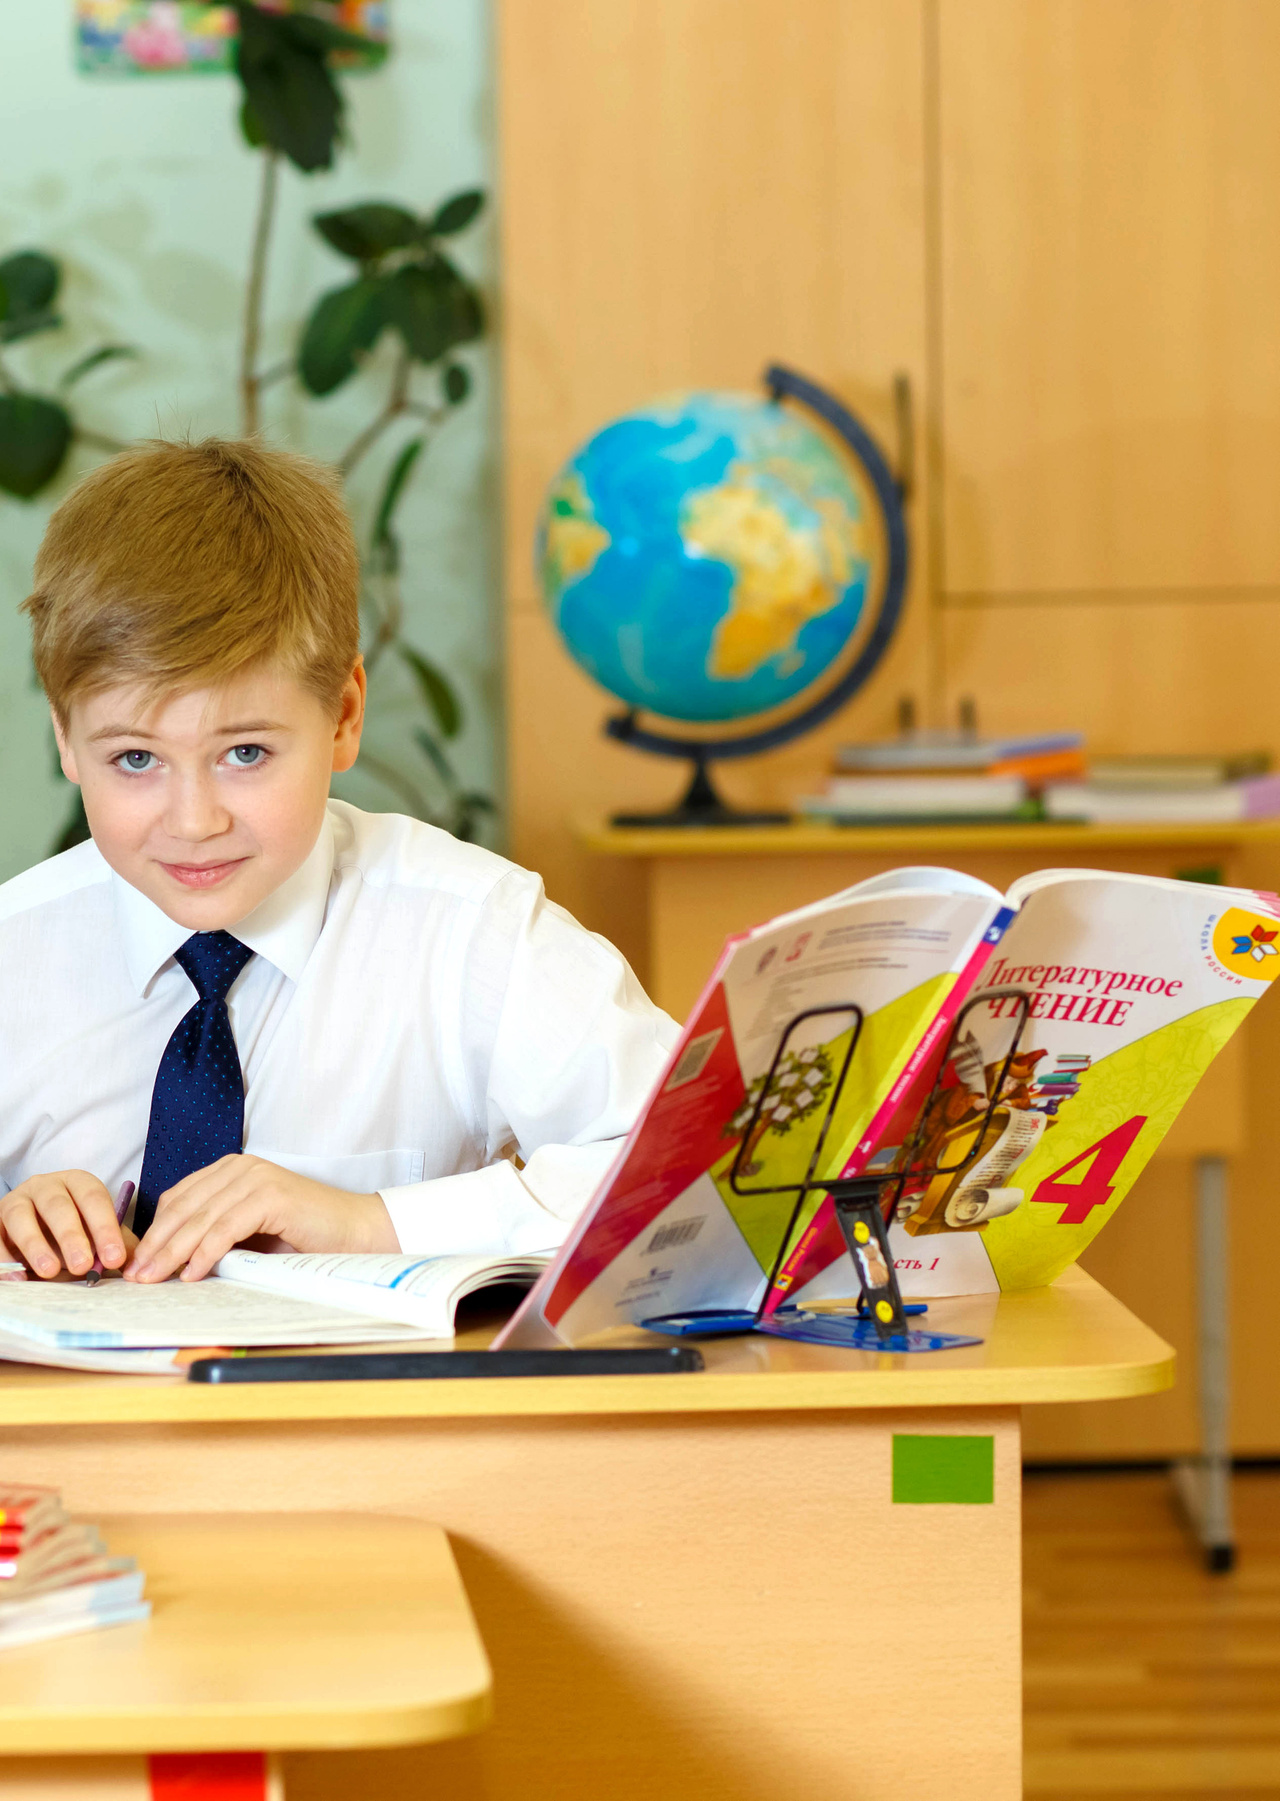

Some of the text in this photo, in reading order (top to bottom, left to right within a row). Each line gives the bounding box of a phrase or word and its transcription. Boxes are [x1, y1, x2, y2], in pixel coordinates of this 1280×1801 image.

[975, 957, 1183, 998] Литературное
[1030, 1115, 1148, 1224] 4
[892, 1257, 941, 1270] сть 1
